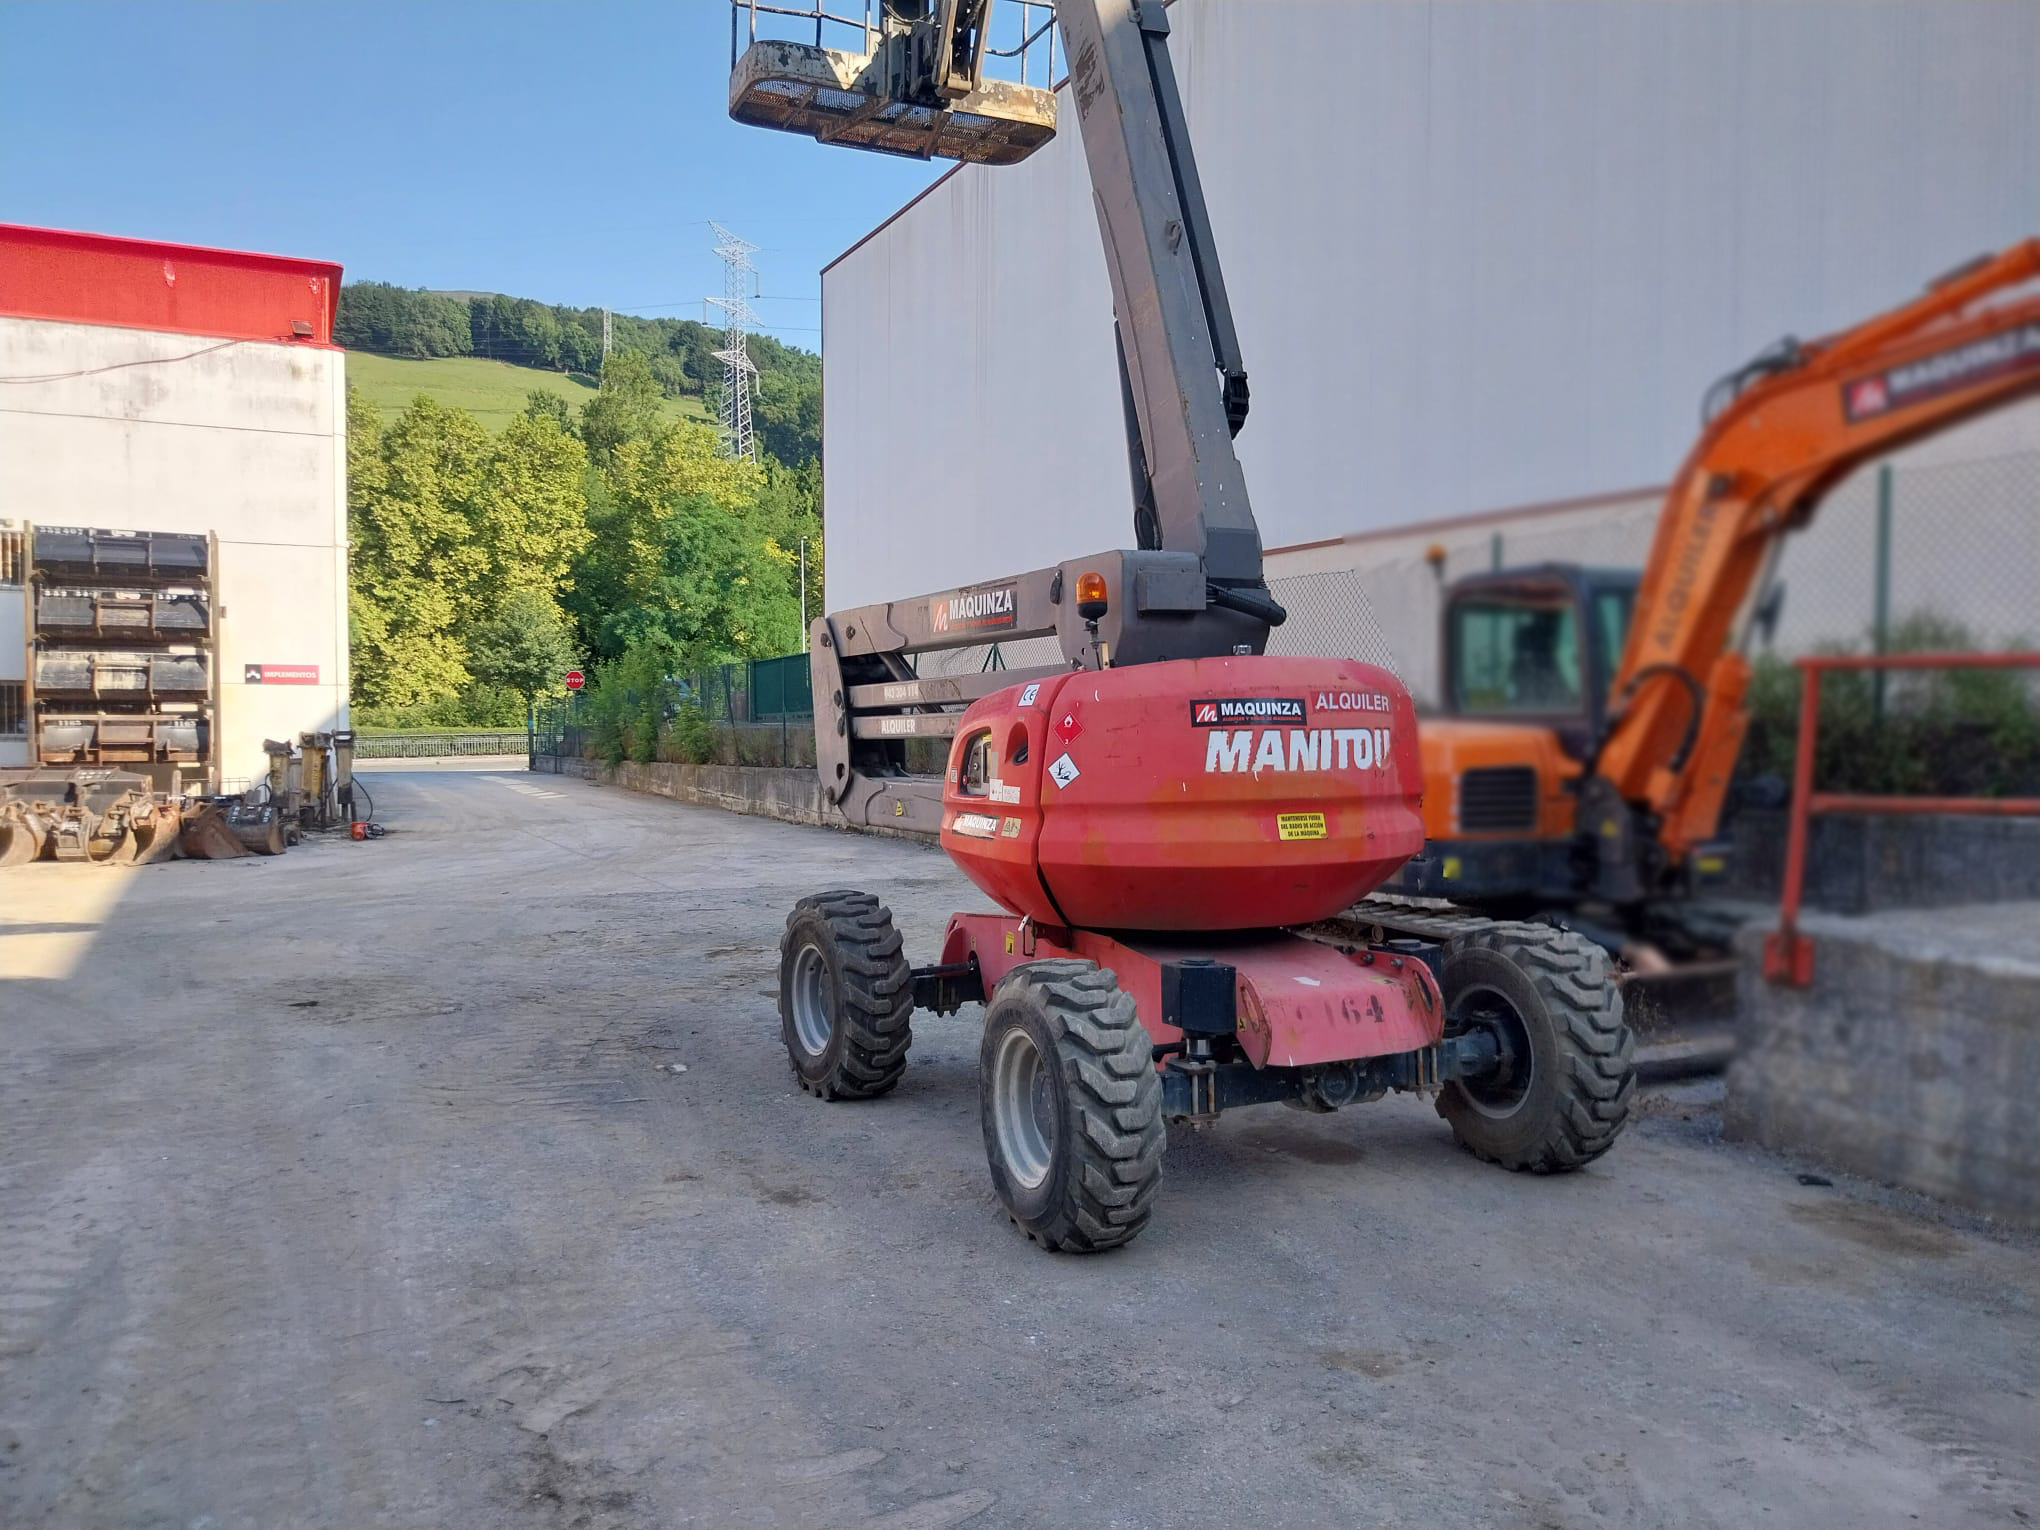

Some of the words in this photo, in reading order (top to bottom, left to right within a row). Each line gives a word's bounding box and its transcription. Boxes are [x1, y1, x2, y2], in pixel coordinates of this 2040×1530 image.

[949, 589, 1013, 620] MAQUINZA
[264, 671, 316, 679] IMPLEMENTOS
[1221, 702, 1301, 716] MAQUINZA
[1315, 692, 1390, 712] ALQUILER
[881, 719, 916, 735] ALQUILER
[1205, 728, 1390, 773] MANITOU
[963, 814, 997, 832] MAQUINZA
